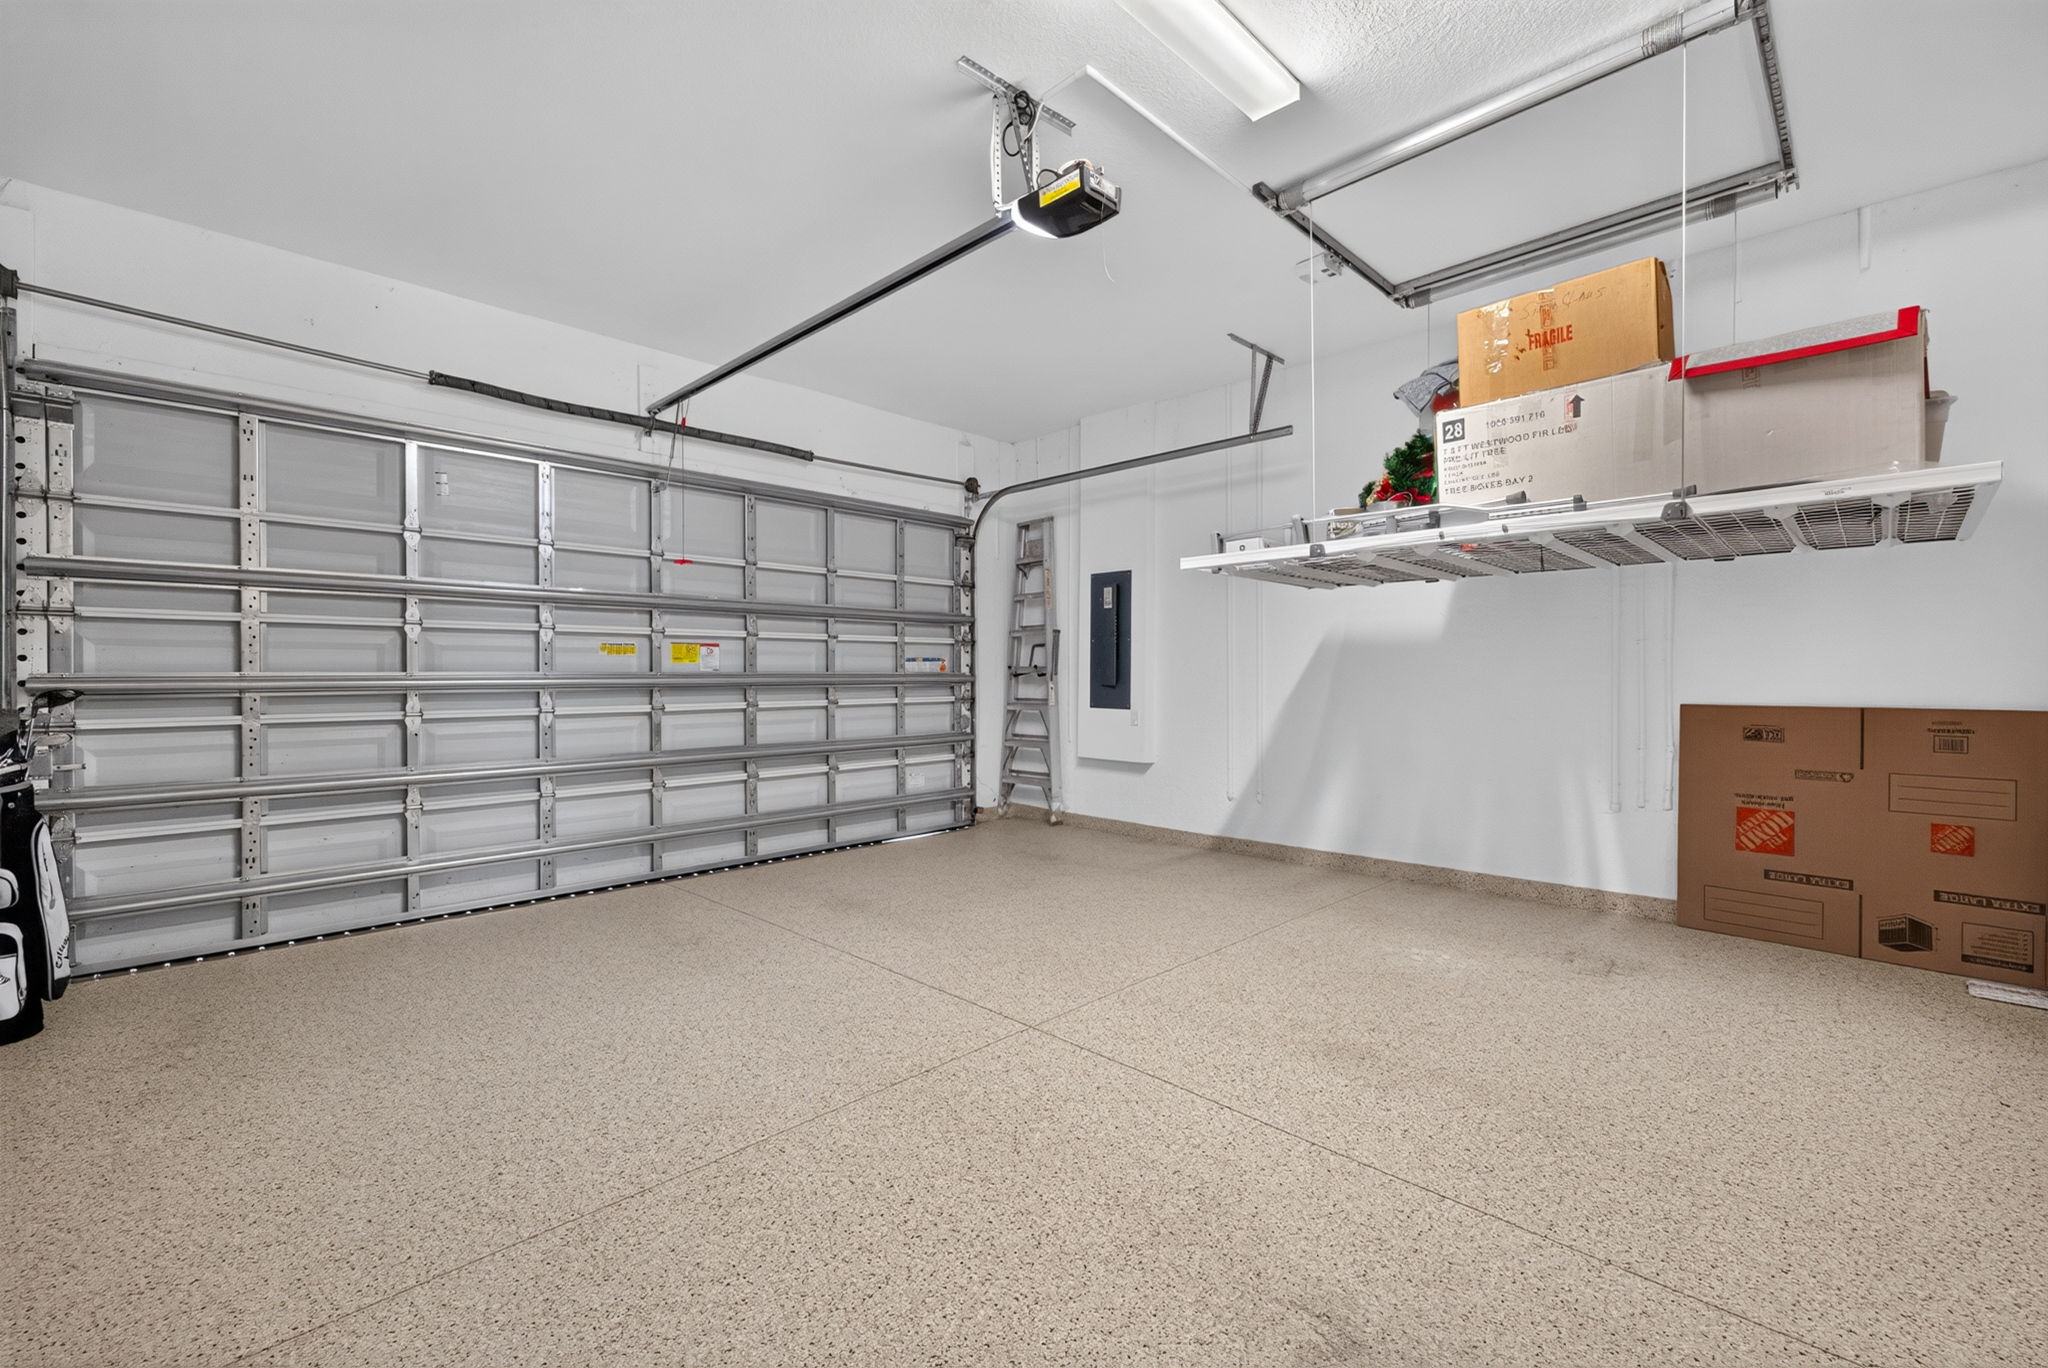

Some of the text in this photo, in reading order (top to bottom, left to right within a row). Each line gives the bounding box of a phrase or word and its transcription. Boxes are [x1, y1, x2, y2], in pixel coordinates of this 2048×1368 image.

[1528, 324, 1573, 351] FRAGILE
[1445, 423, 1463, 440] 28
[1471, 433, 1530, 451] WESTWOOD
[1532, 428, 1549, 439] FIR
[1939, 892, 2041, 913] EXTRA LARGE
